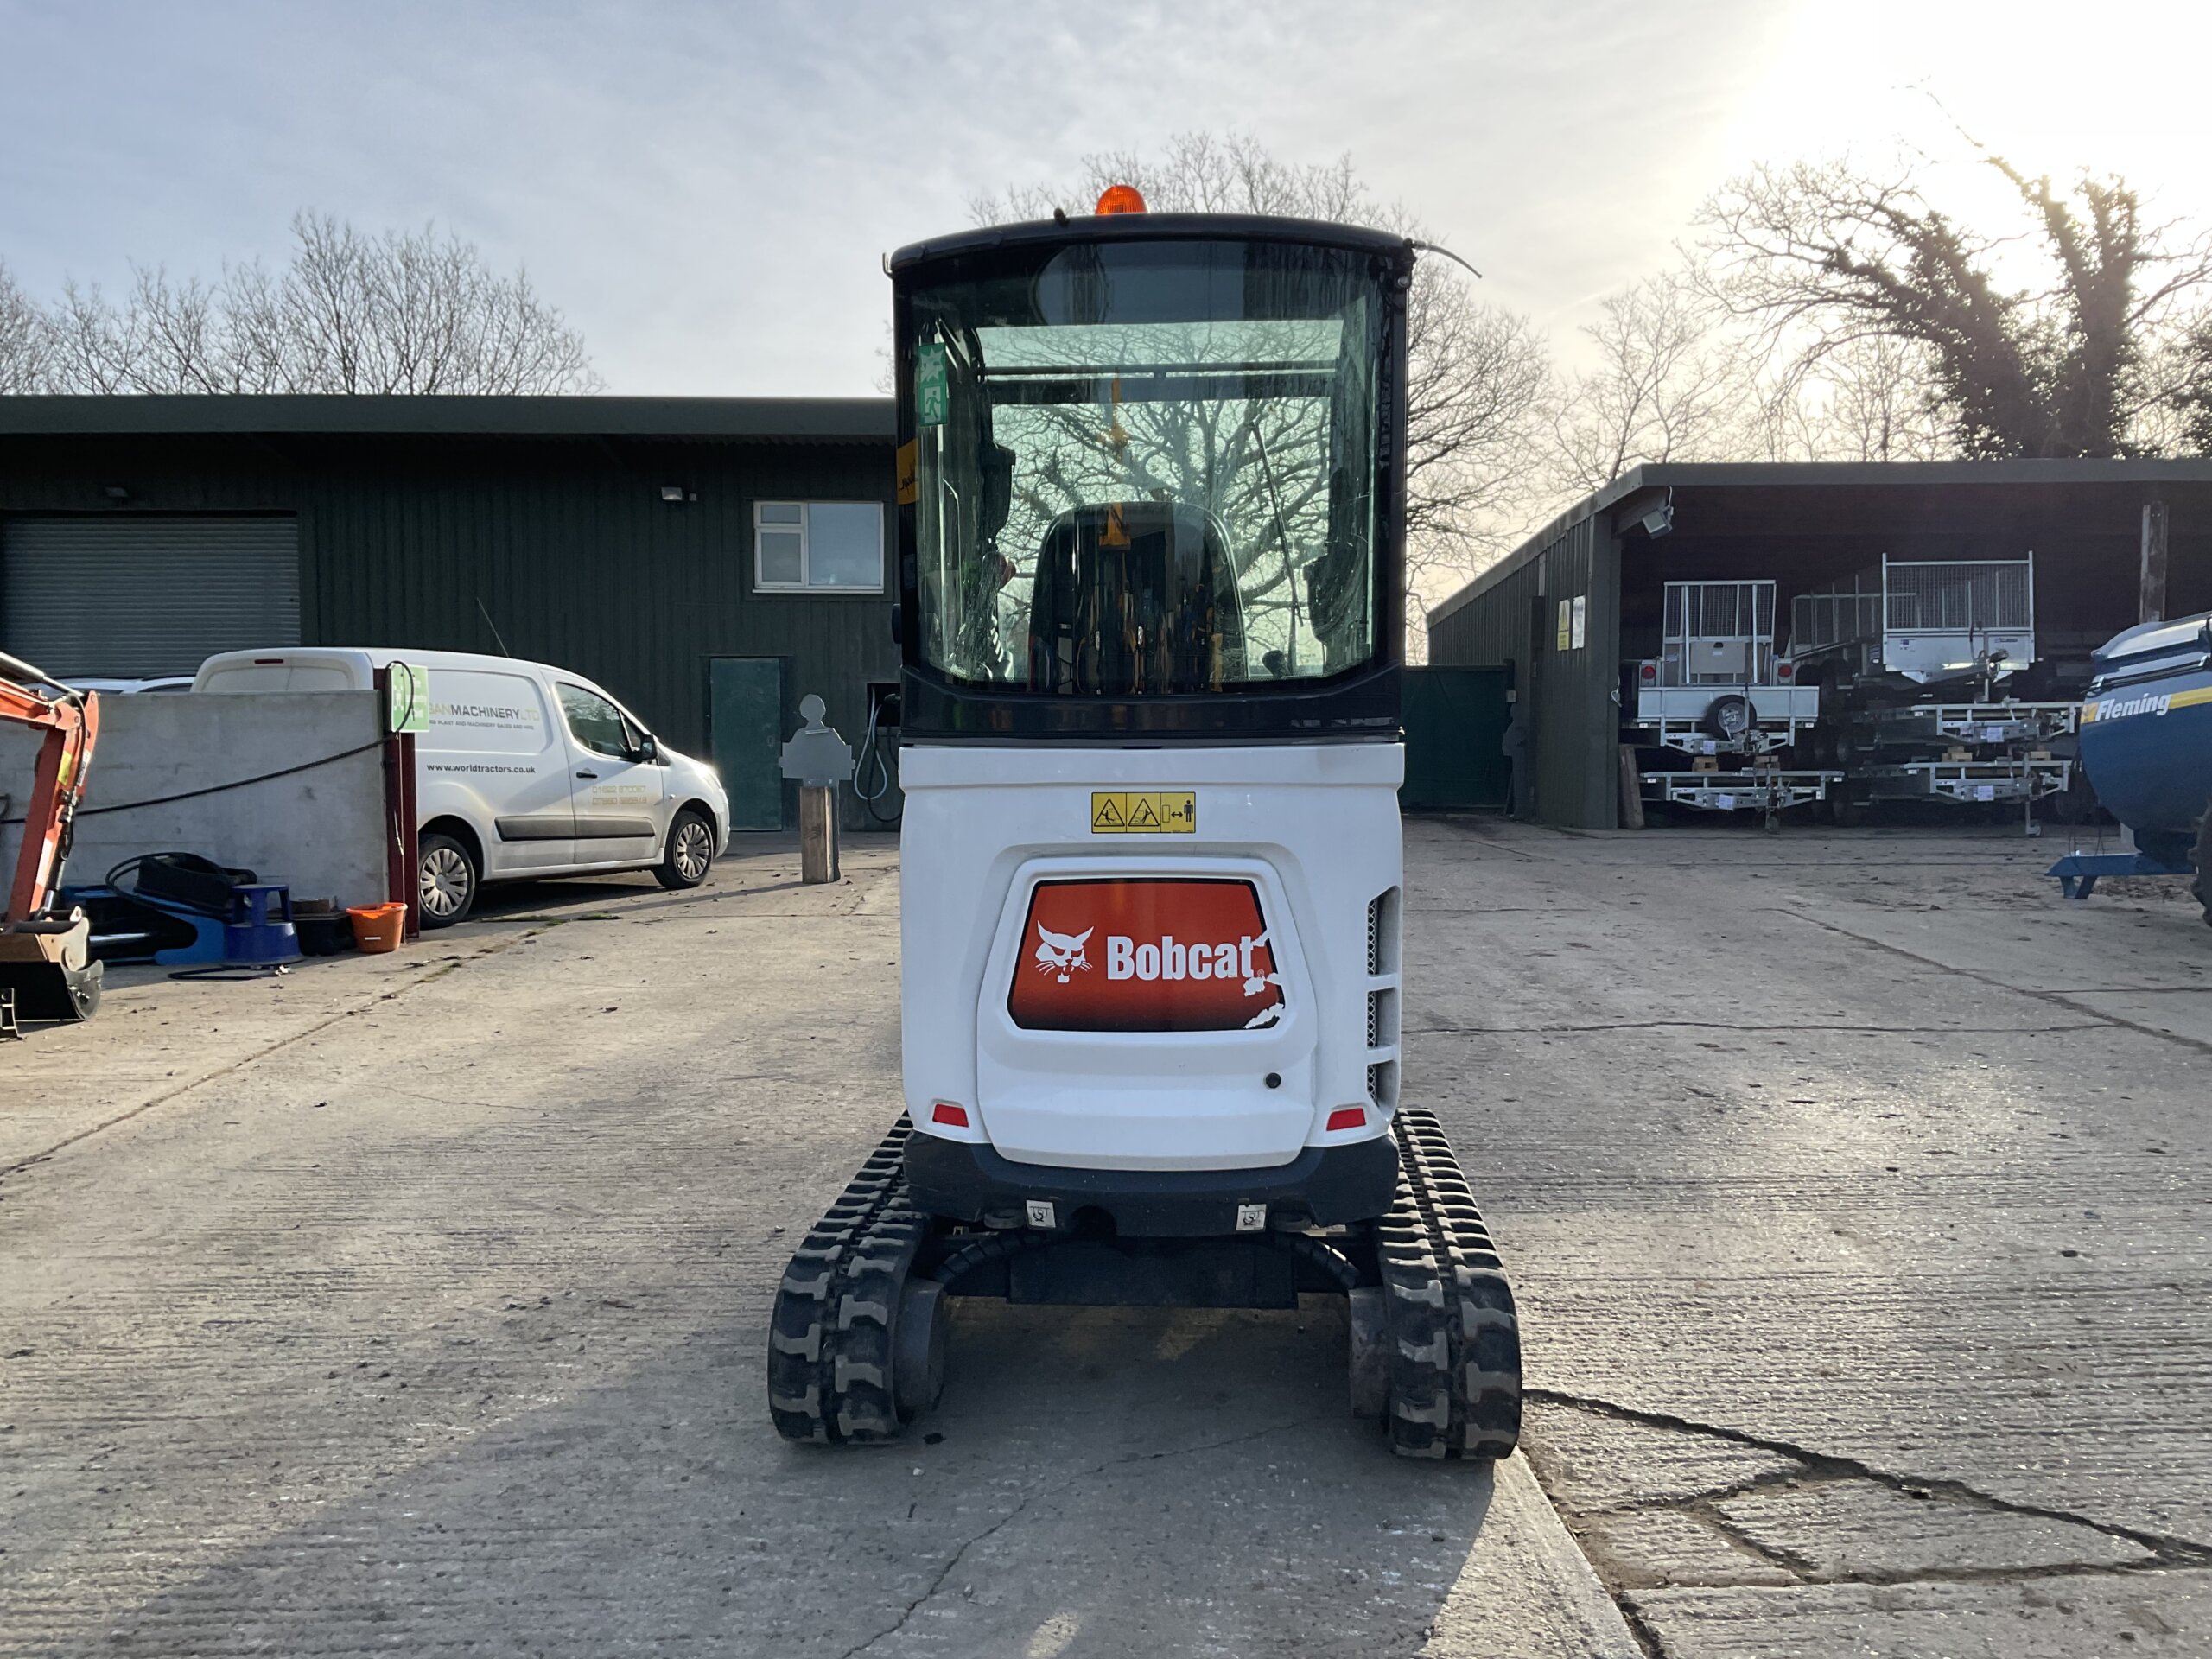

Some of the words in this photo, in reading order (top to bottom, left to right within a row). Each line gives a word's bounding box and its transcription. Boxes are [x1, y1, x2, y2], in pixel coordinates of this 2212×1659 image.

[2095, 692, 2171, 721] Fleming
[426, 764, 536, 774] www.worldtractors.co.uk
[1107, 935, 1255, 981] Bobcat
